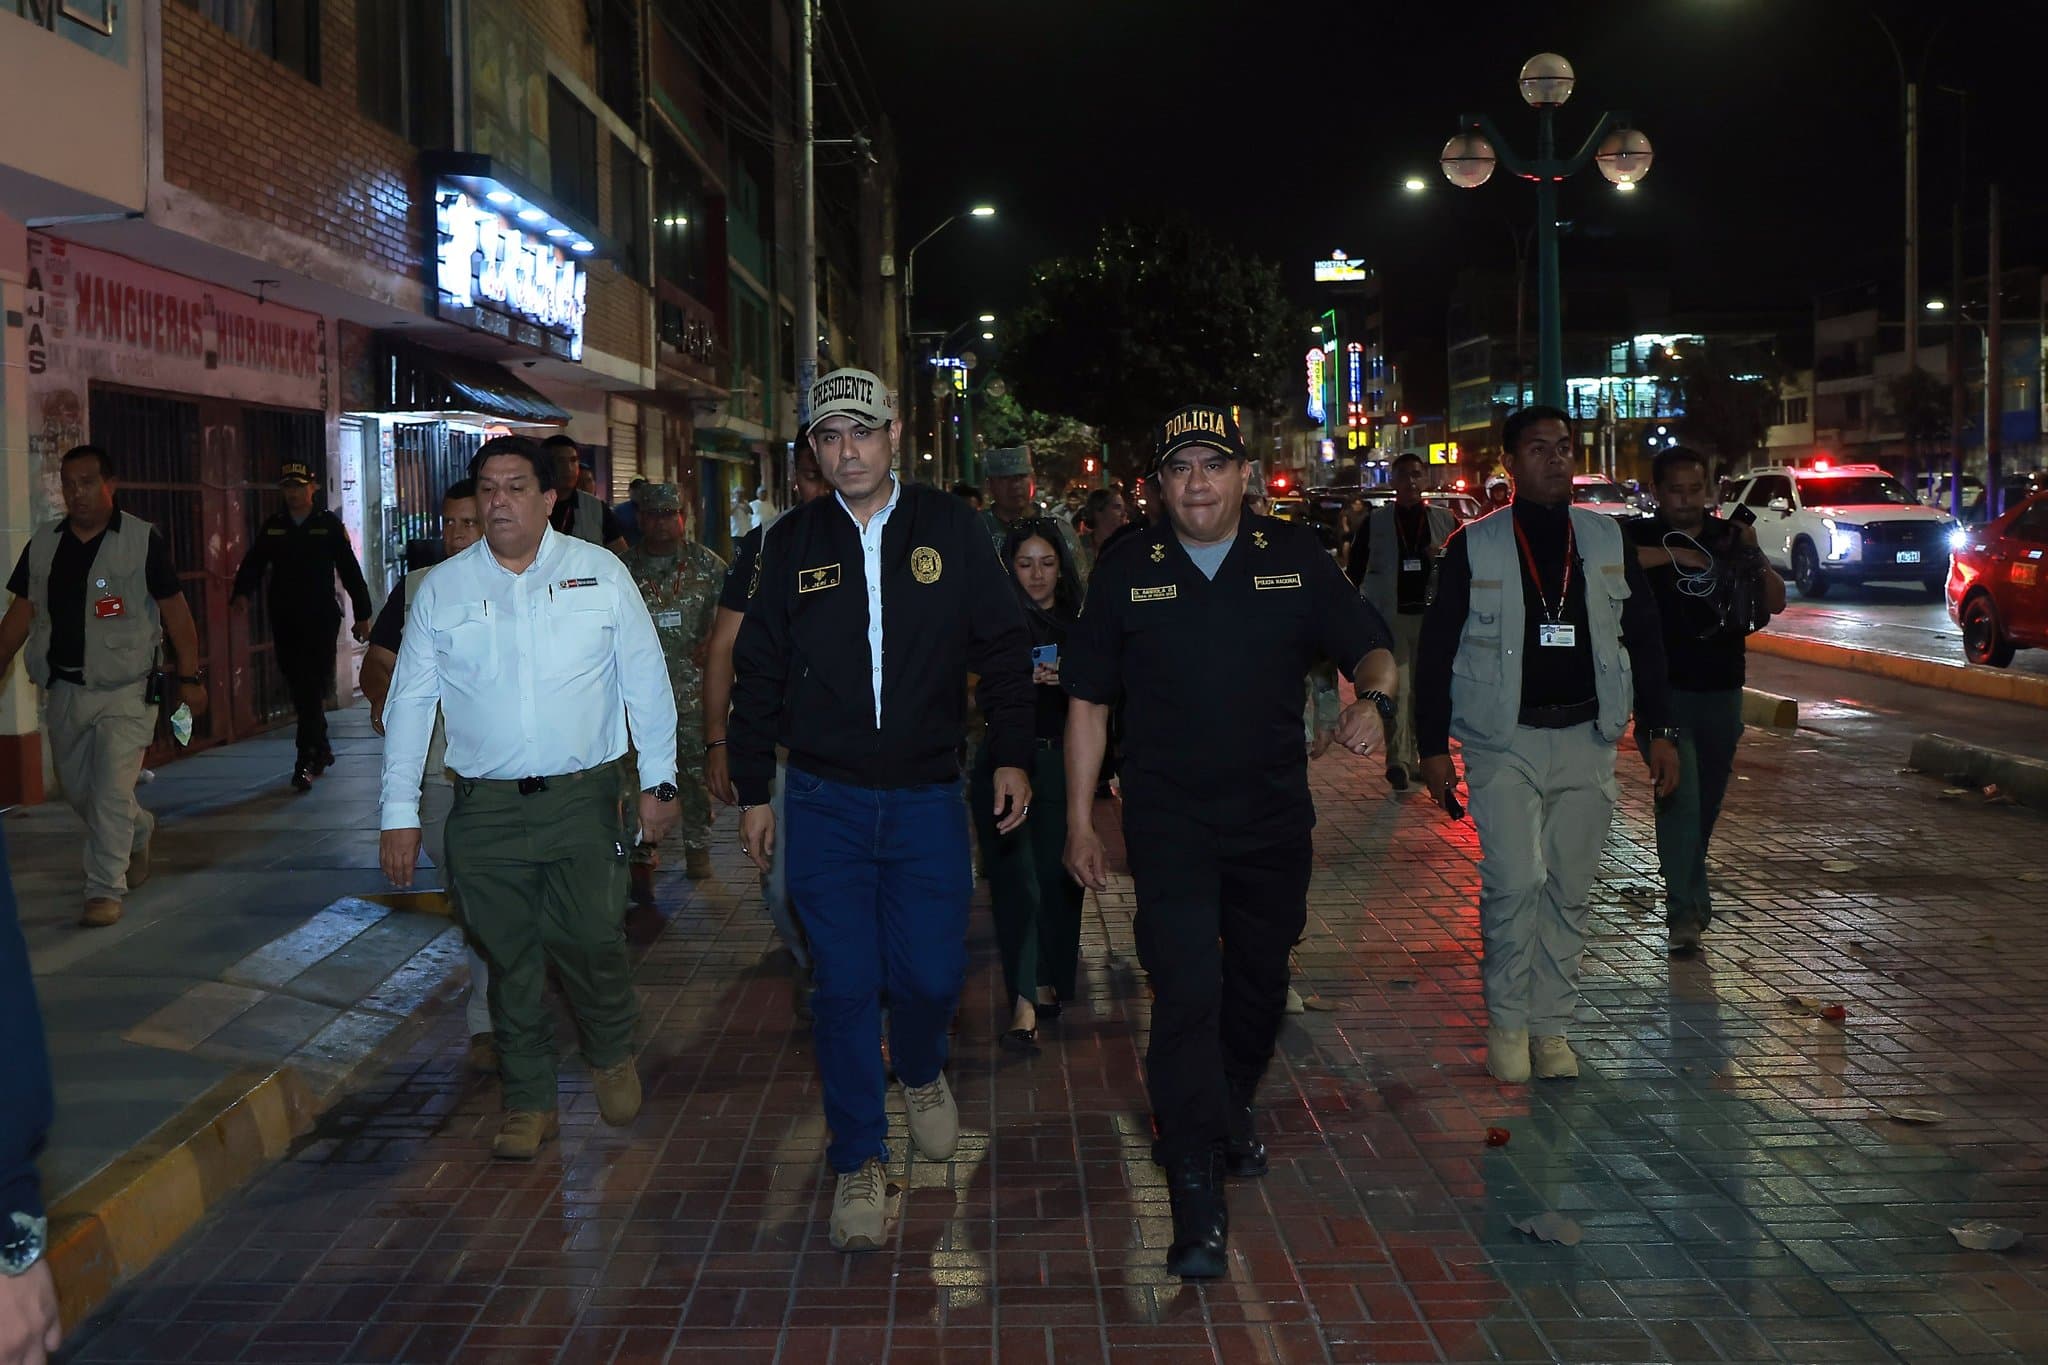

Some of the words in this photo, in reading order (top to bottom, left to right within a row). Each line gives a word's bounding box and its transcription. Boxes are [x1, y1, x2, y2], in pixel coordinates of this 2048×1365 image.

[27, 238, 46, 374] FAJAS
[74, 271, 202, 355] MANGUERAS
[813, 375, 874, 411] PRESIDENTE
[1164, 410, 1227, 444] POLICIA
